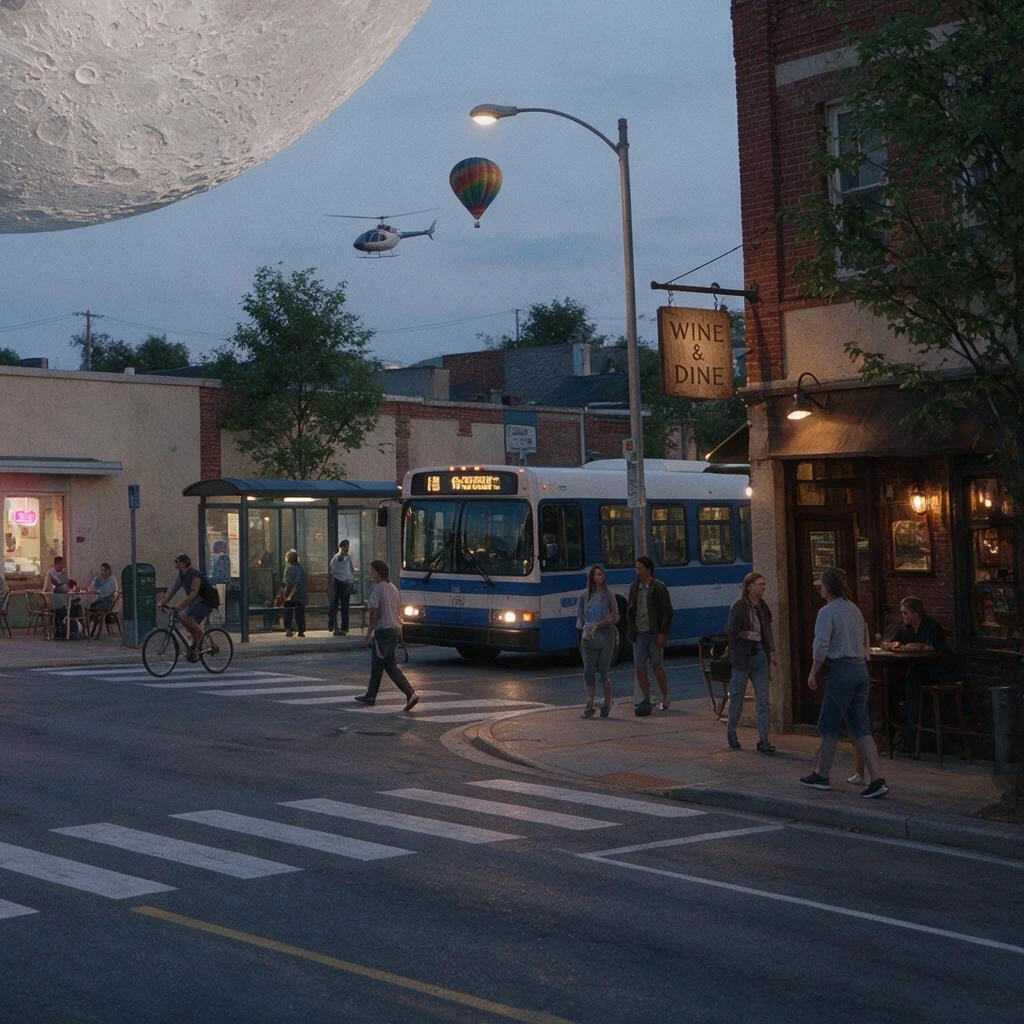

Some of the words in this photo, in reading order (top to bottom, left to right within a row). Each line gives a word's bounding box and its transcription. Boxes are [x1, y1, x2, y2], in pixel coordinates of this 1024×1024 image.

[669, 321, 724, 343] WINE
[692, 343, 705, 361] &
[675, 364, 725, 386] DINE
